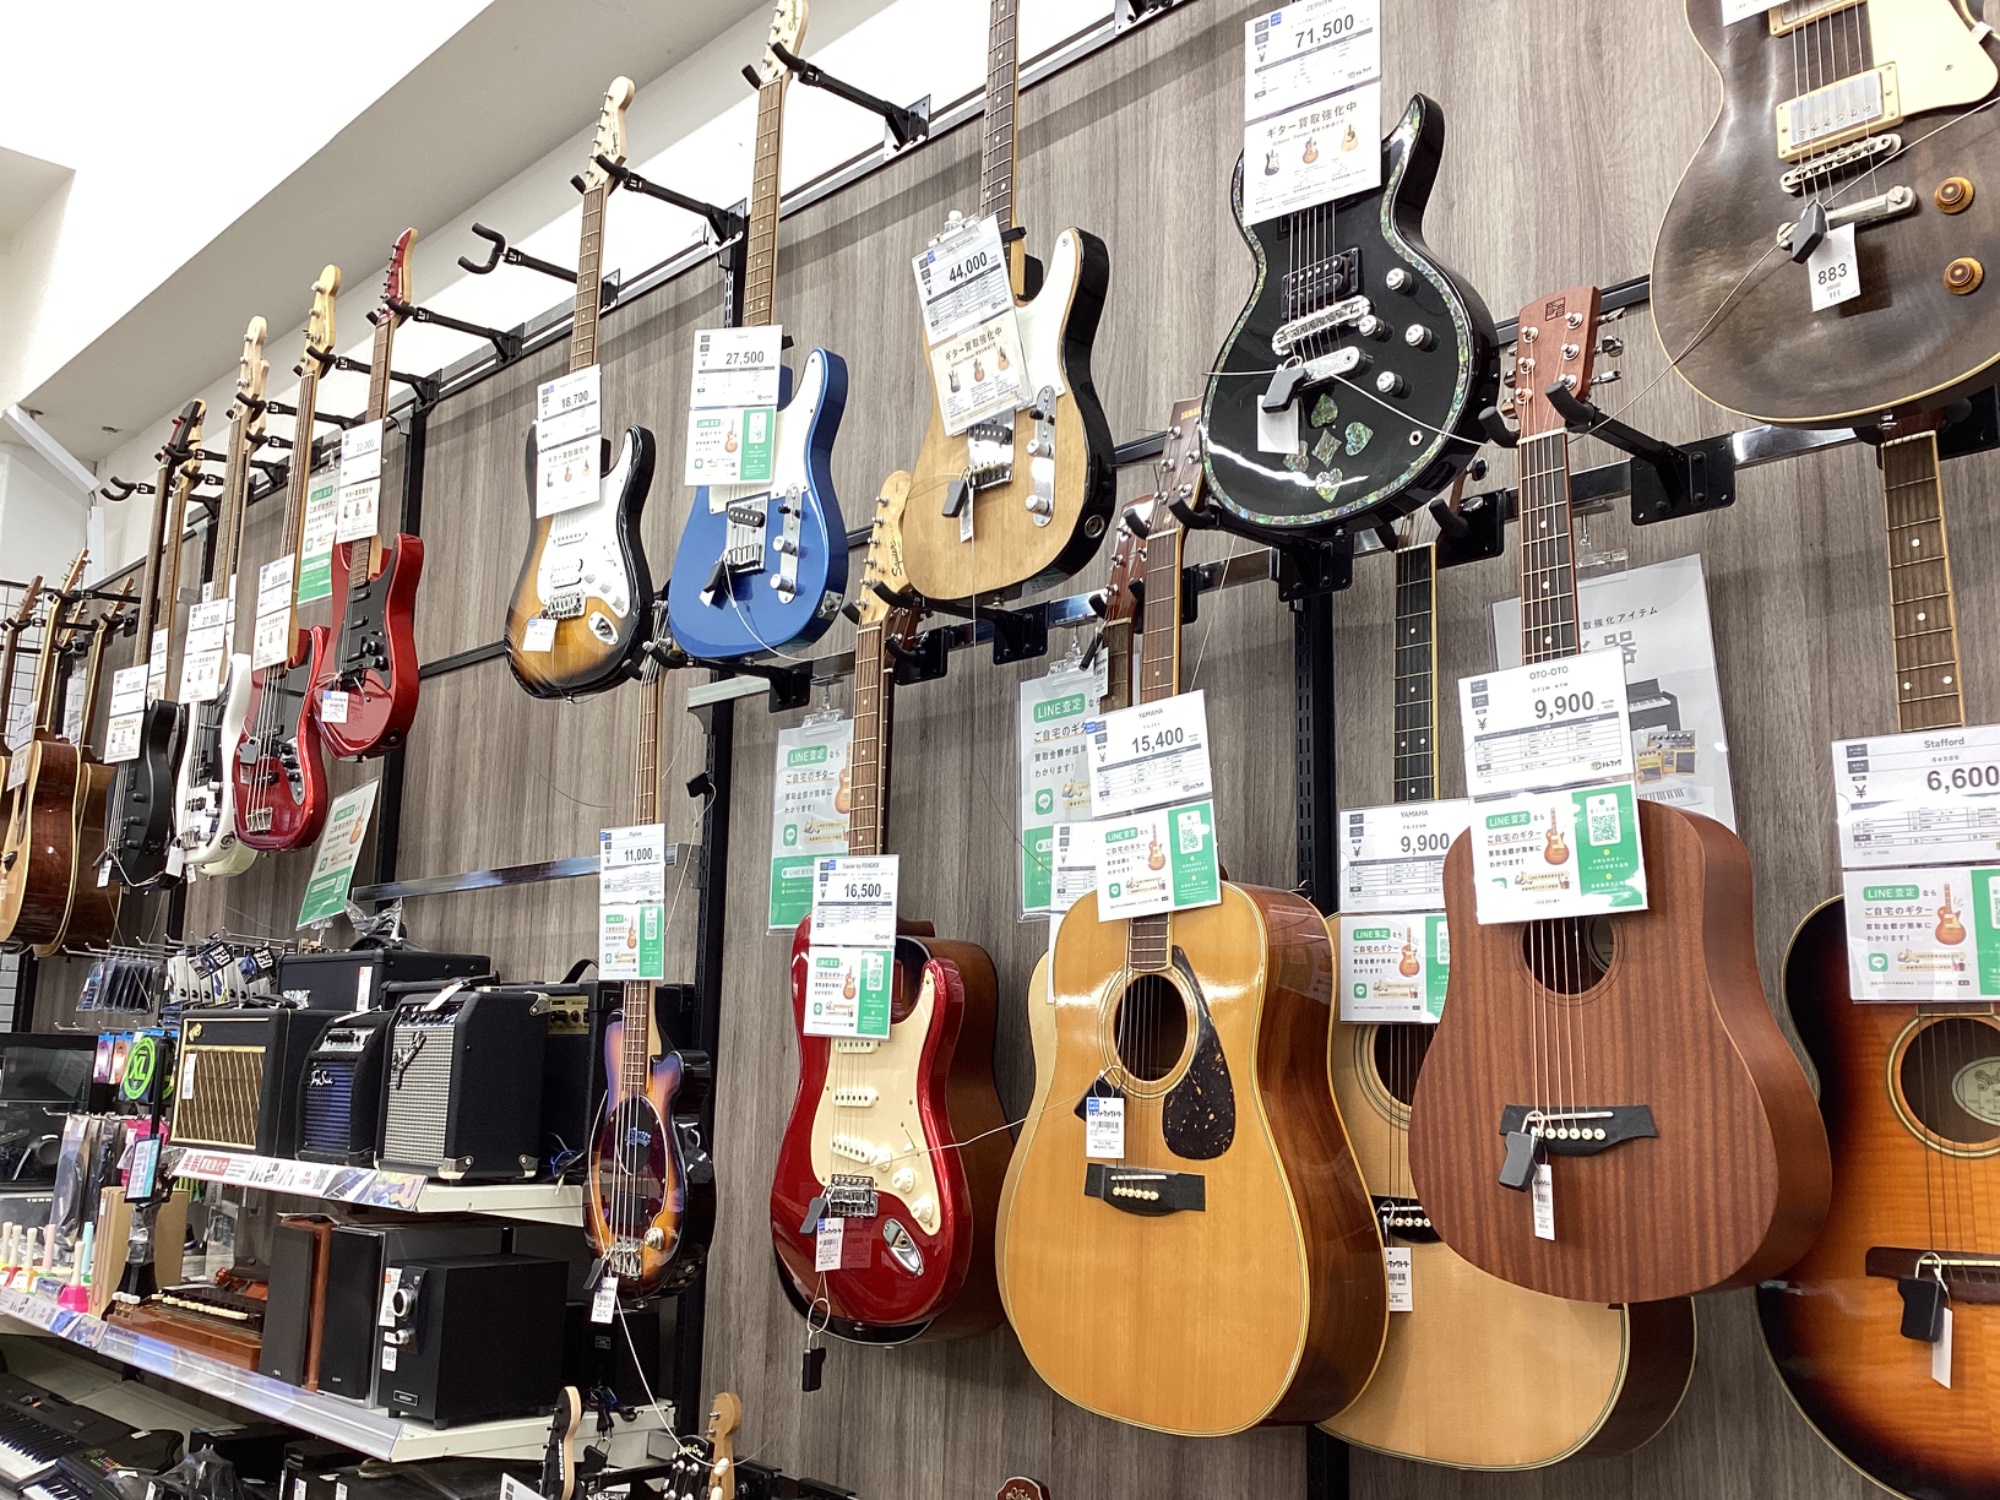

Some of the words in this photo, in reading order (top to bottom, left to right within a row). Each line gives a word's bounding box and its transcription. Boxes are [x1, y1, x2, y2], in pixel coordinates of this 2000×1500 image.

[1295, 14, 1354, 49] 71,500
[1267, 101, 1357, 139] ギター買取強化中
[949, 251, 988, 282] 44,000
[1818, 263, 1847, 285] 883
[945, 326, 1002, 361] ギター買取強化中
[725, 351, 764, 366] 27,500
[561, 390, 589, 409] 18,700
[1582, 606, 1658, 631] 取強化アイテム
[1529, 666, 1568, 680] OTO-OTO
[1138, 708, 1163, 719] YAMAHA
[1478, 718, 1487, 731] ¥
[1535, 691, 1594, 720] 9,900
[1132, 727, 1184, 754] 15,400
[1924, 736, 1965, 749] Stafford
[785, 770, 835, 785] ご自宅のギター
[1855, 784, 1866, 798] ¥
[1927, 765, 2000, 794] 6,600
[1400, 809, 1428, 819] YAMAHA
[1353, 846, 1361, 857] ¥
[1401, 833, 1450, 855] 9,900
[1488, 831, 1542, 844] ご自宅のギター
[625, 848, 652, 862] 11,000
[1106, 843, 1146, 856] ご自宅のギター
[1488, 845, 1541, 857] 買取金額が簡単に
[844, 883, 881, 900] 16,500
[1922, 889, 1937, 897] なら
[1865, 906, 1933, 916] ご自宅のギター
[1866, 922, 1932, 931] 買取金額が簡単に
[1353, 944, 1398, 953] ご自宅のギター
